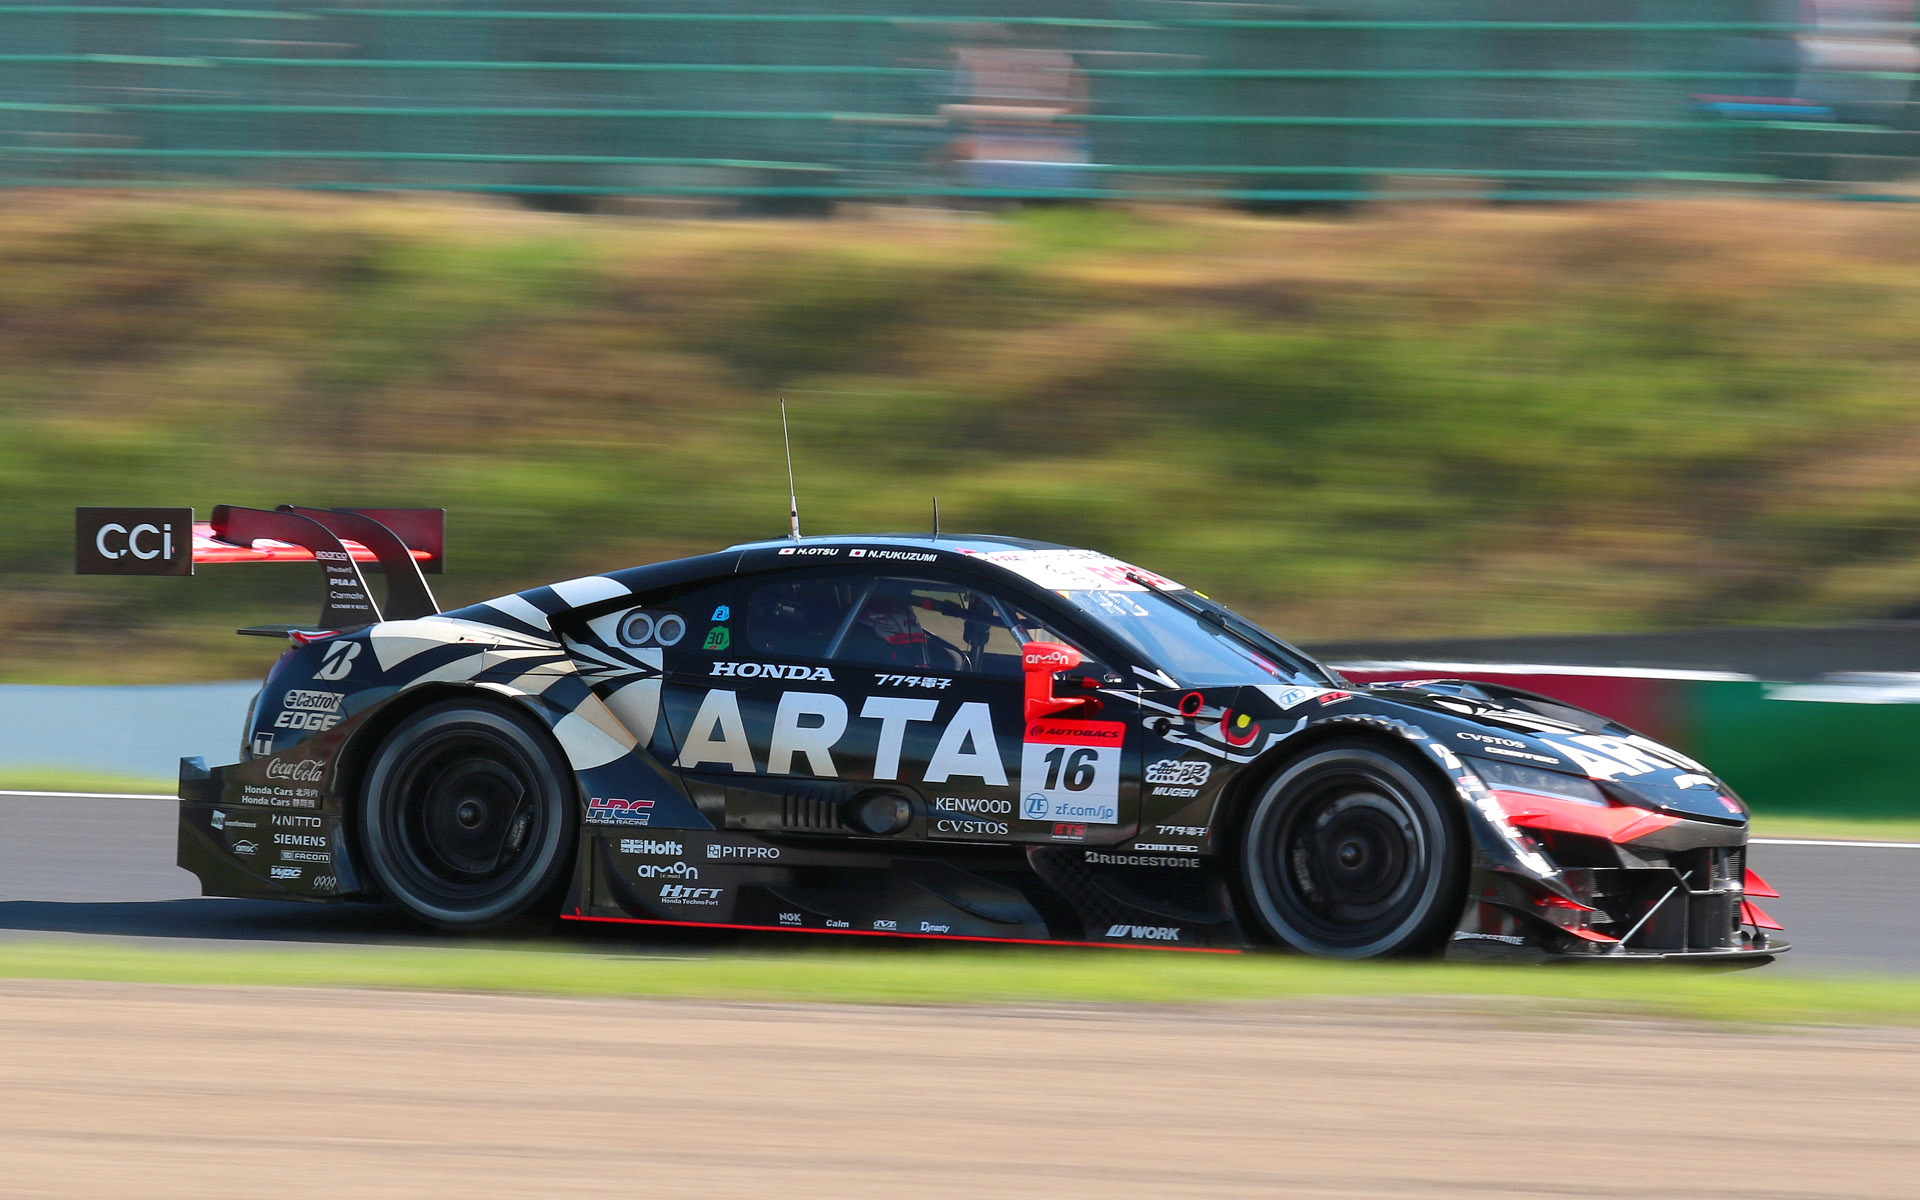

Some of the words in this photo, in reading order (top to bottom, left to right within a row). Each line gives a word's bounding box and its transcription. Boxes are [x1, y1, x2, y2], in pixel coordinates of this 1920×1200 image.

[95, 522, 172, 560] CCi
[315, 550, 348, 560] sparco
[797, 547, 840, 557] H.OTSU
[867, 549, 939, 563] N.FUKUZUMI
[329, 577, 359, 587] PIAA
[329, 590, 365, 600] Carmate
[716, 610, 724, 619] 2
[707, 632, 725, 645] 30
[1025, 651, 1069, 665] amon
[708, 661, 836, 683] HONDA
[296, 691, 338, 710] Castrol
[273, 711, 343, 732] EDGE
[671, 688, 1010, 788] ARTA
[1045, 726, 1120, 739] AUTOBACS
[265, 757, 327, 783] Coca-Cola
[1043, 747, 1099, 793] 16
[245, 785, 272, 795] Honda
[273, 787, 294, 797] Cars
[1151, 787, 1200, 798] MUGEN
[241, 795, 269, 805] Honda
[270, 797, 291, 807] Cars
[935, 797, 1012, 815] KENWOOD
[585, 797, 656, 821] HRC
[1054, 803, 1115, 820] zf.com/jp
[282, 815, 322, 828] NITTO
[616, 819, 649, 827] RACING
[936, 818, 1009, 836] CVSTOS
[273, 833, 327, 847] SIEMENS
[643, 839, 683, 856] Holts
[722, 846, 780, 859] PITPRO
[1085, 850, 1200, 868] BRIDGESTONE
[637, 861, 699, 880] amon
[658, 883, 723, 899] HTFT
[779, 912, 802, 922] NGK
[825, 919, 850, 928] Calm
[920, 920, 951, 933] Dynasty
[1131, 926, 1181, 941] WORK
